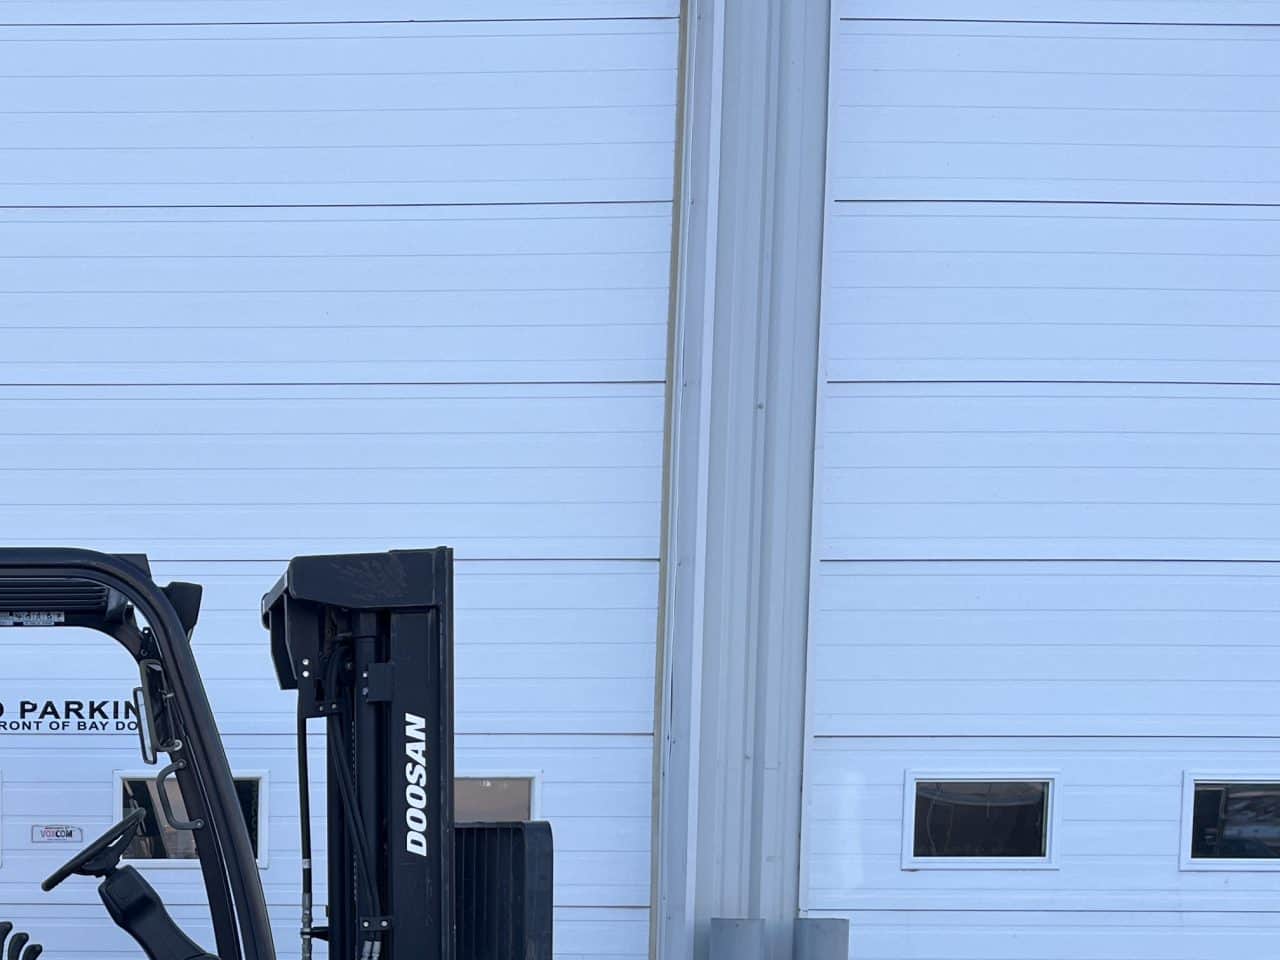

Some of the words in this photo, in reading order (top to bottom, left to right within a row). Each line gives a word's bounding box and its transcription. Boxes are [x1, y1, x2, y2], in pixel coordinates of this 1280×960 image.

[48, 720, 70, 730] OF
[77, 720, 109, 730] BAY
[115, 720, 137, 730] DO
[405, 712, 428, 856] DOOSAN
